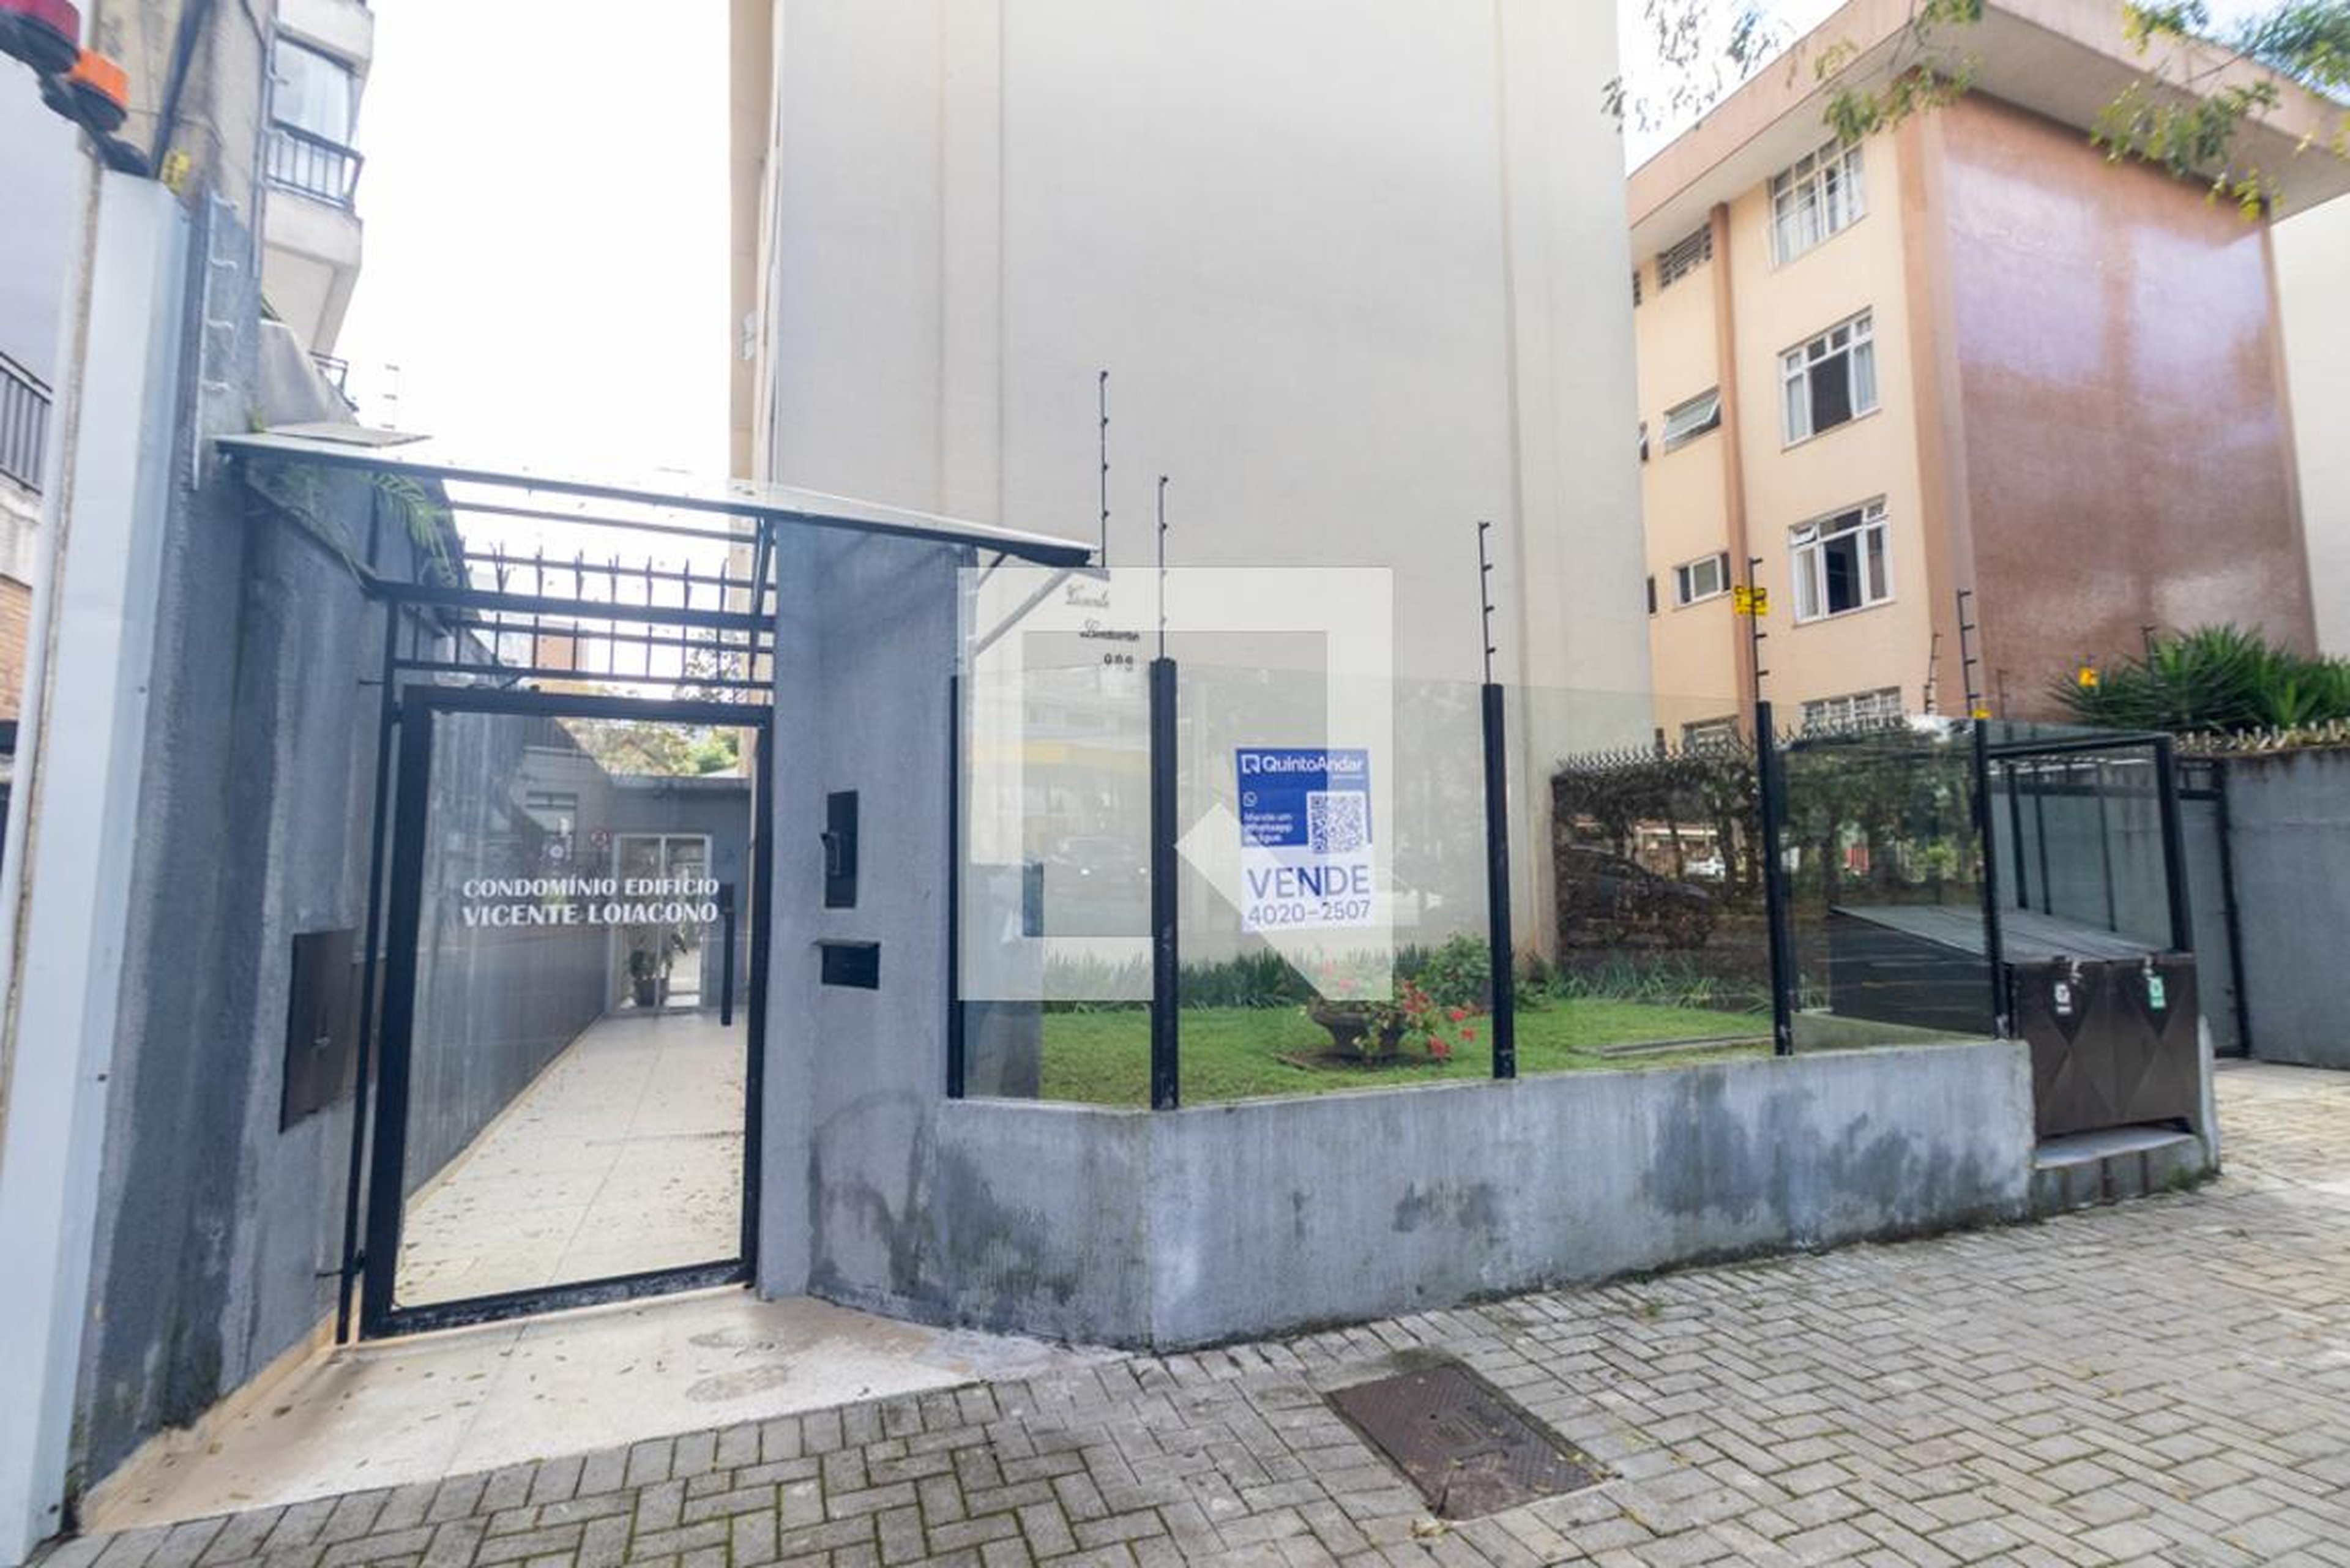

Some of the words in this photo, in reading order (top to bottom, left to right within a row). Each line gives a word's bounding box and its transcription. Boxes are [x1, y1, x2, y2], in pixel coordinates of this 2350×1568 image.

[1263, 755, 1362, 772] QuintoAndar
[463, 875, 617, 898] CONDOMÍNIO
[1247, 865, 1370, 898] VENDE
[462, 903, 578, 927] VICENTE
[588, 902, 718, 923] LOIACONO
[1248, 900, 1371, 925] 4020-2507
